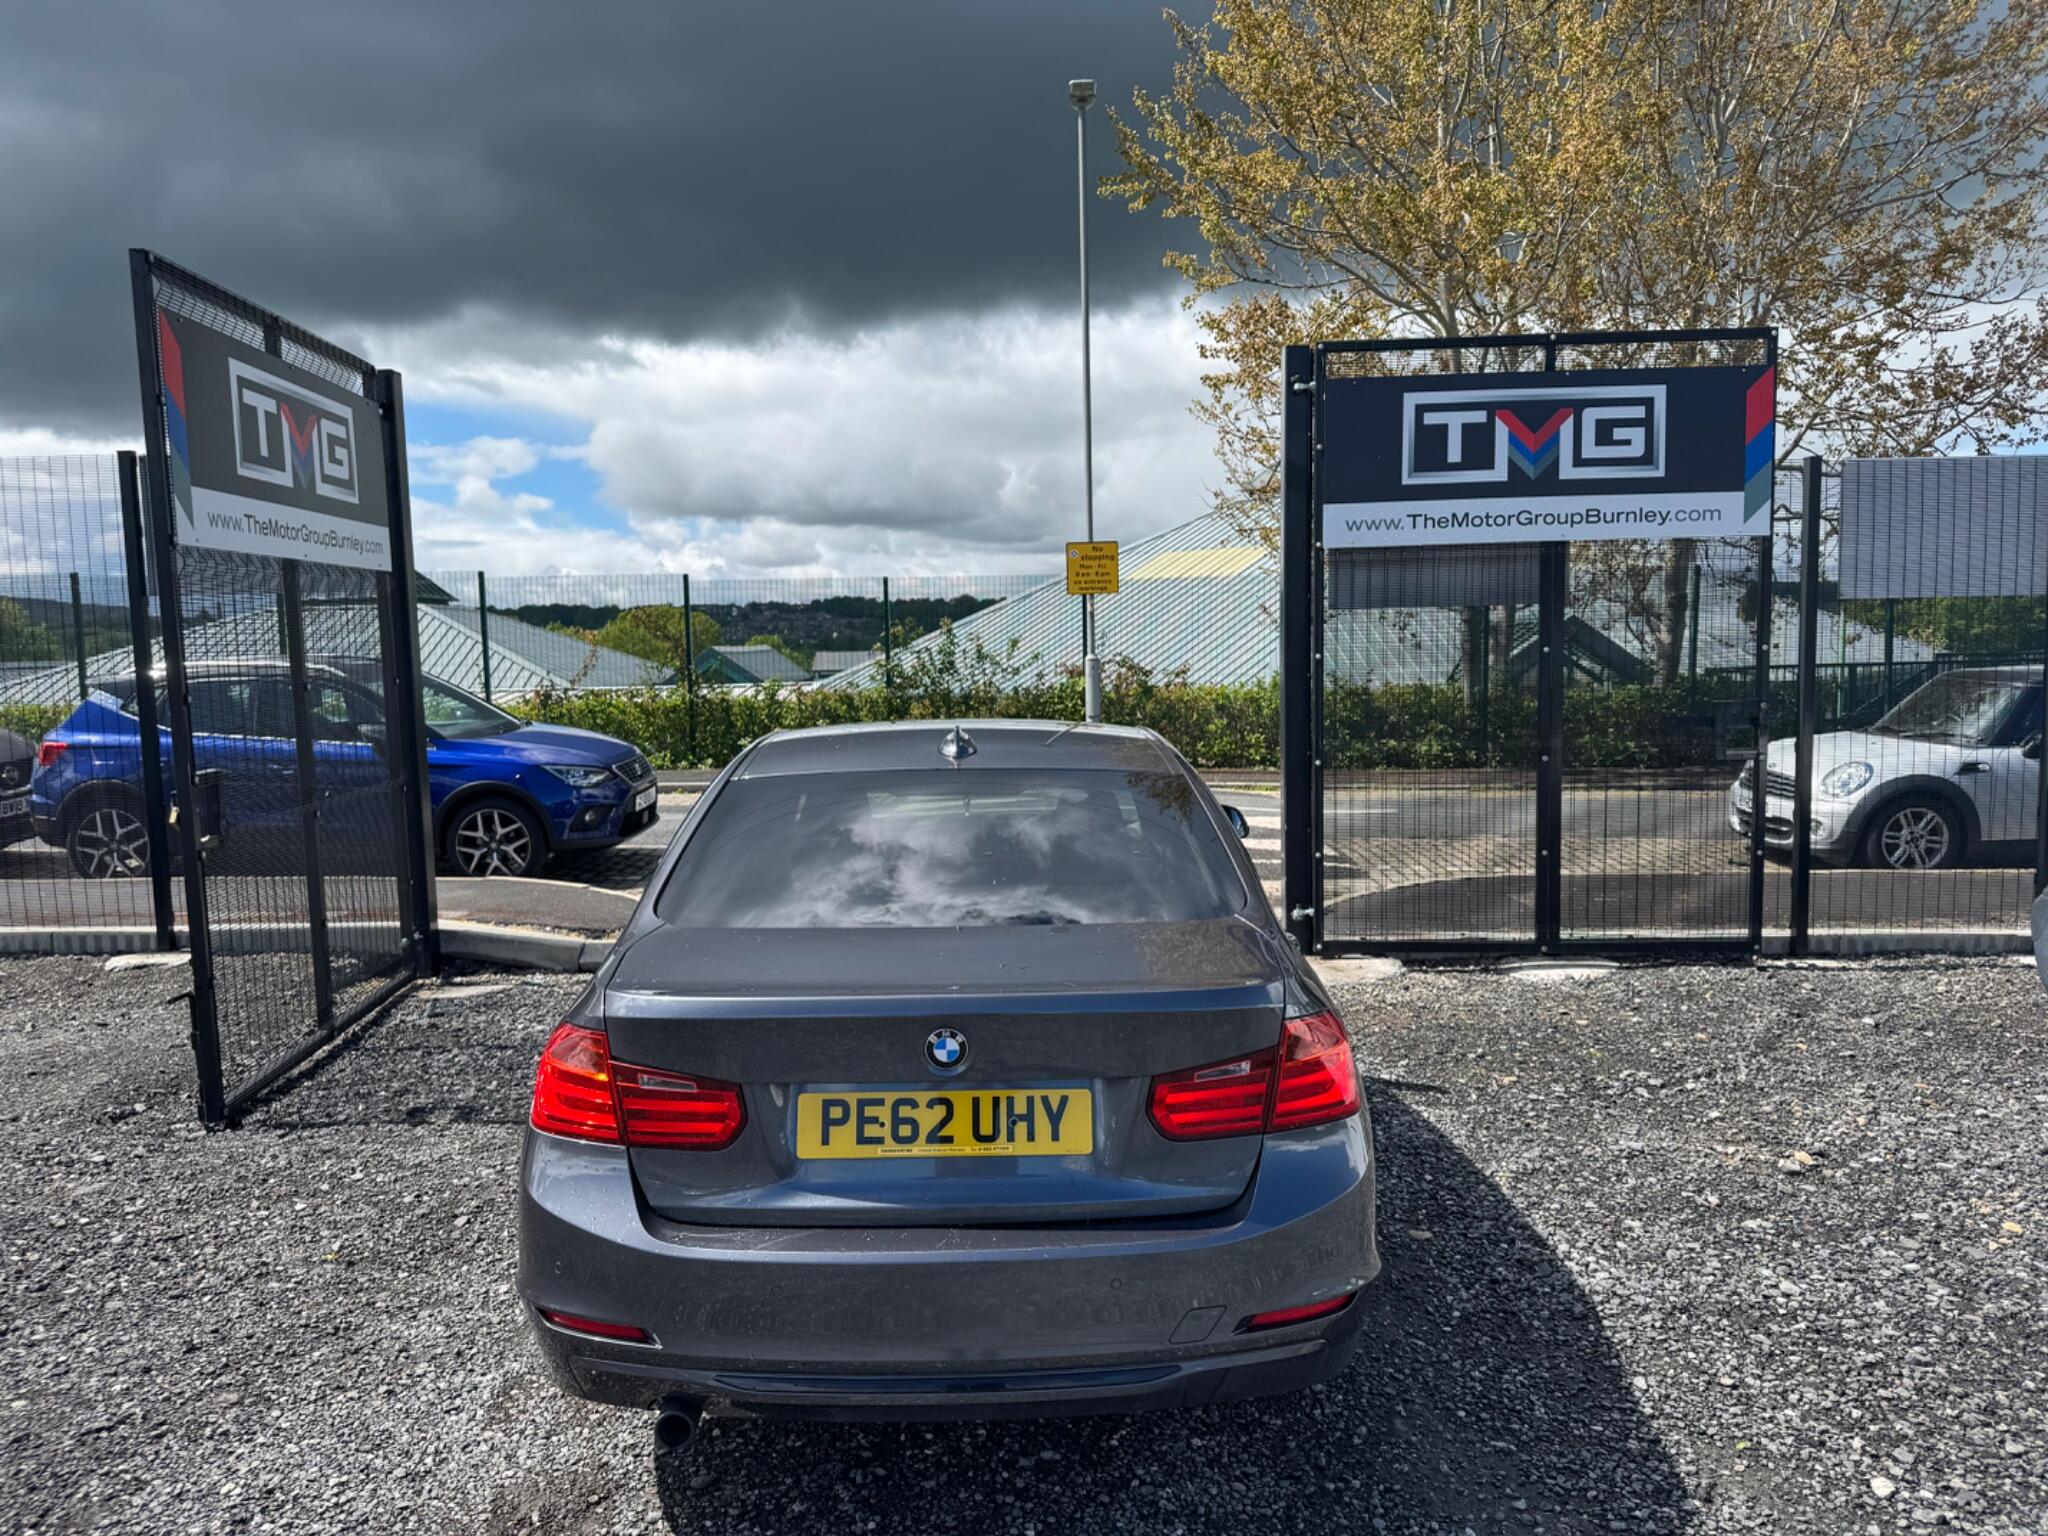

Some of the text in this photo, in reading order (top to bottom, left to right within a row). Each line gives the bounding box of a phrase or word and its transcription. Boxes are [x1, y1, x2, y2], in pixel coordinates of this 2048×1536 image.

[241, 387, 351, 490] TMG
[1422, 405, 1646, 481] TMG
[207, 509, 384, 556] www.TheMotorGroupBurnley.com
[1344, 505, 1722, 534] www.TheMotorGroupBurnley.com
[1081, 553, 1115, 561] stopping
[820, 1094, 1069, 1146] PE62 UHY
